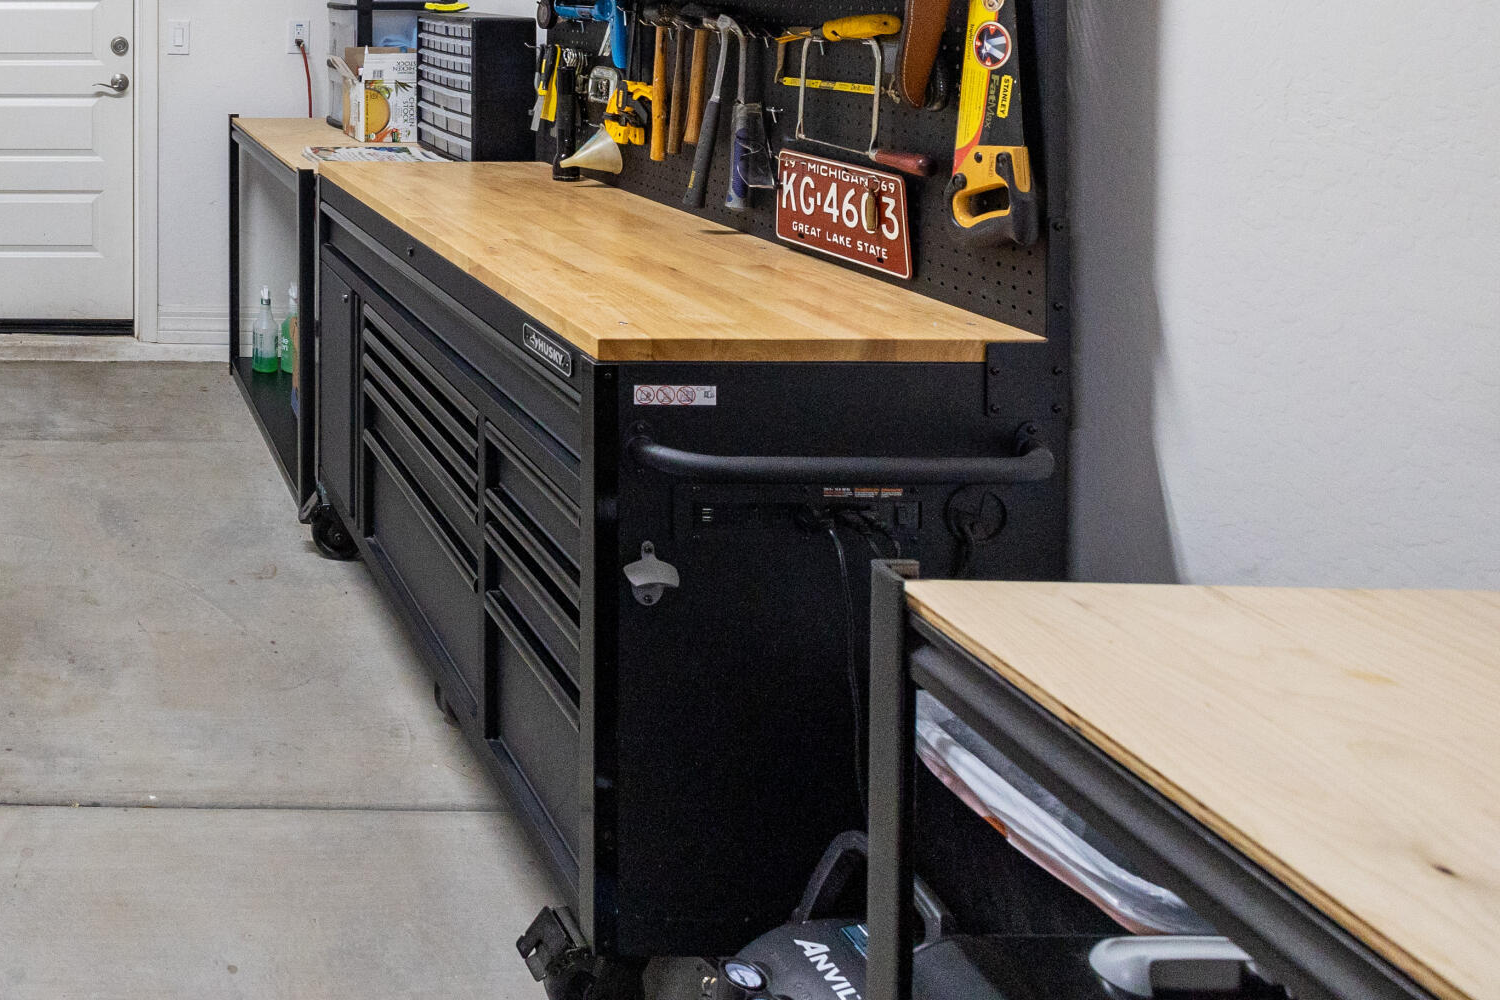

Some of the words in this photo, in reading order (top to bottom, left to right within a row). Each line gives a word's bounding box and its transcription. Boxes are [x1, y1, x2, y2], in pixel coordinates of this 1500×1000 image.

[1000, 77, 1010, 114] STANLEY
[784, 159, 796, 168] 19
[808, 162, 869, 186] MICHIGAN
[881, 180, 896, 193] 69
[792, 221, 821, 238] GREAT
[826, 231, 852, 248] LAKE
[857, 241, 888, 259] STATE
[538, 338, 564, 367] HUSKY
